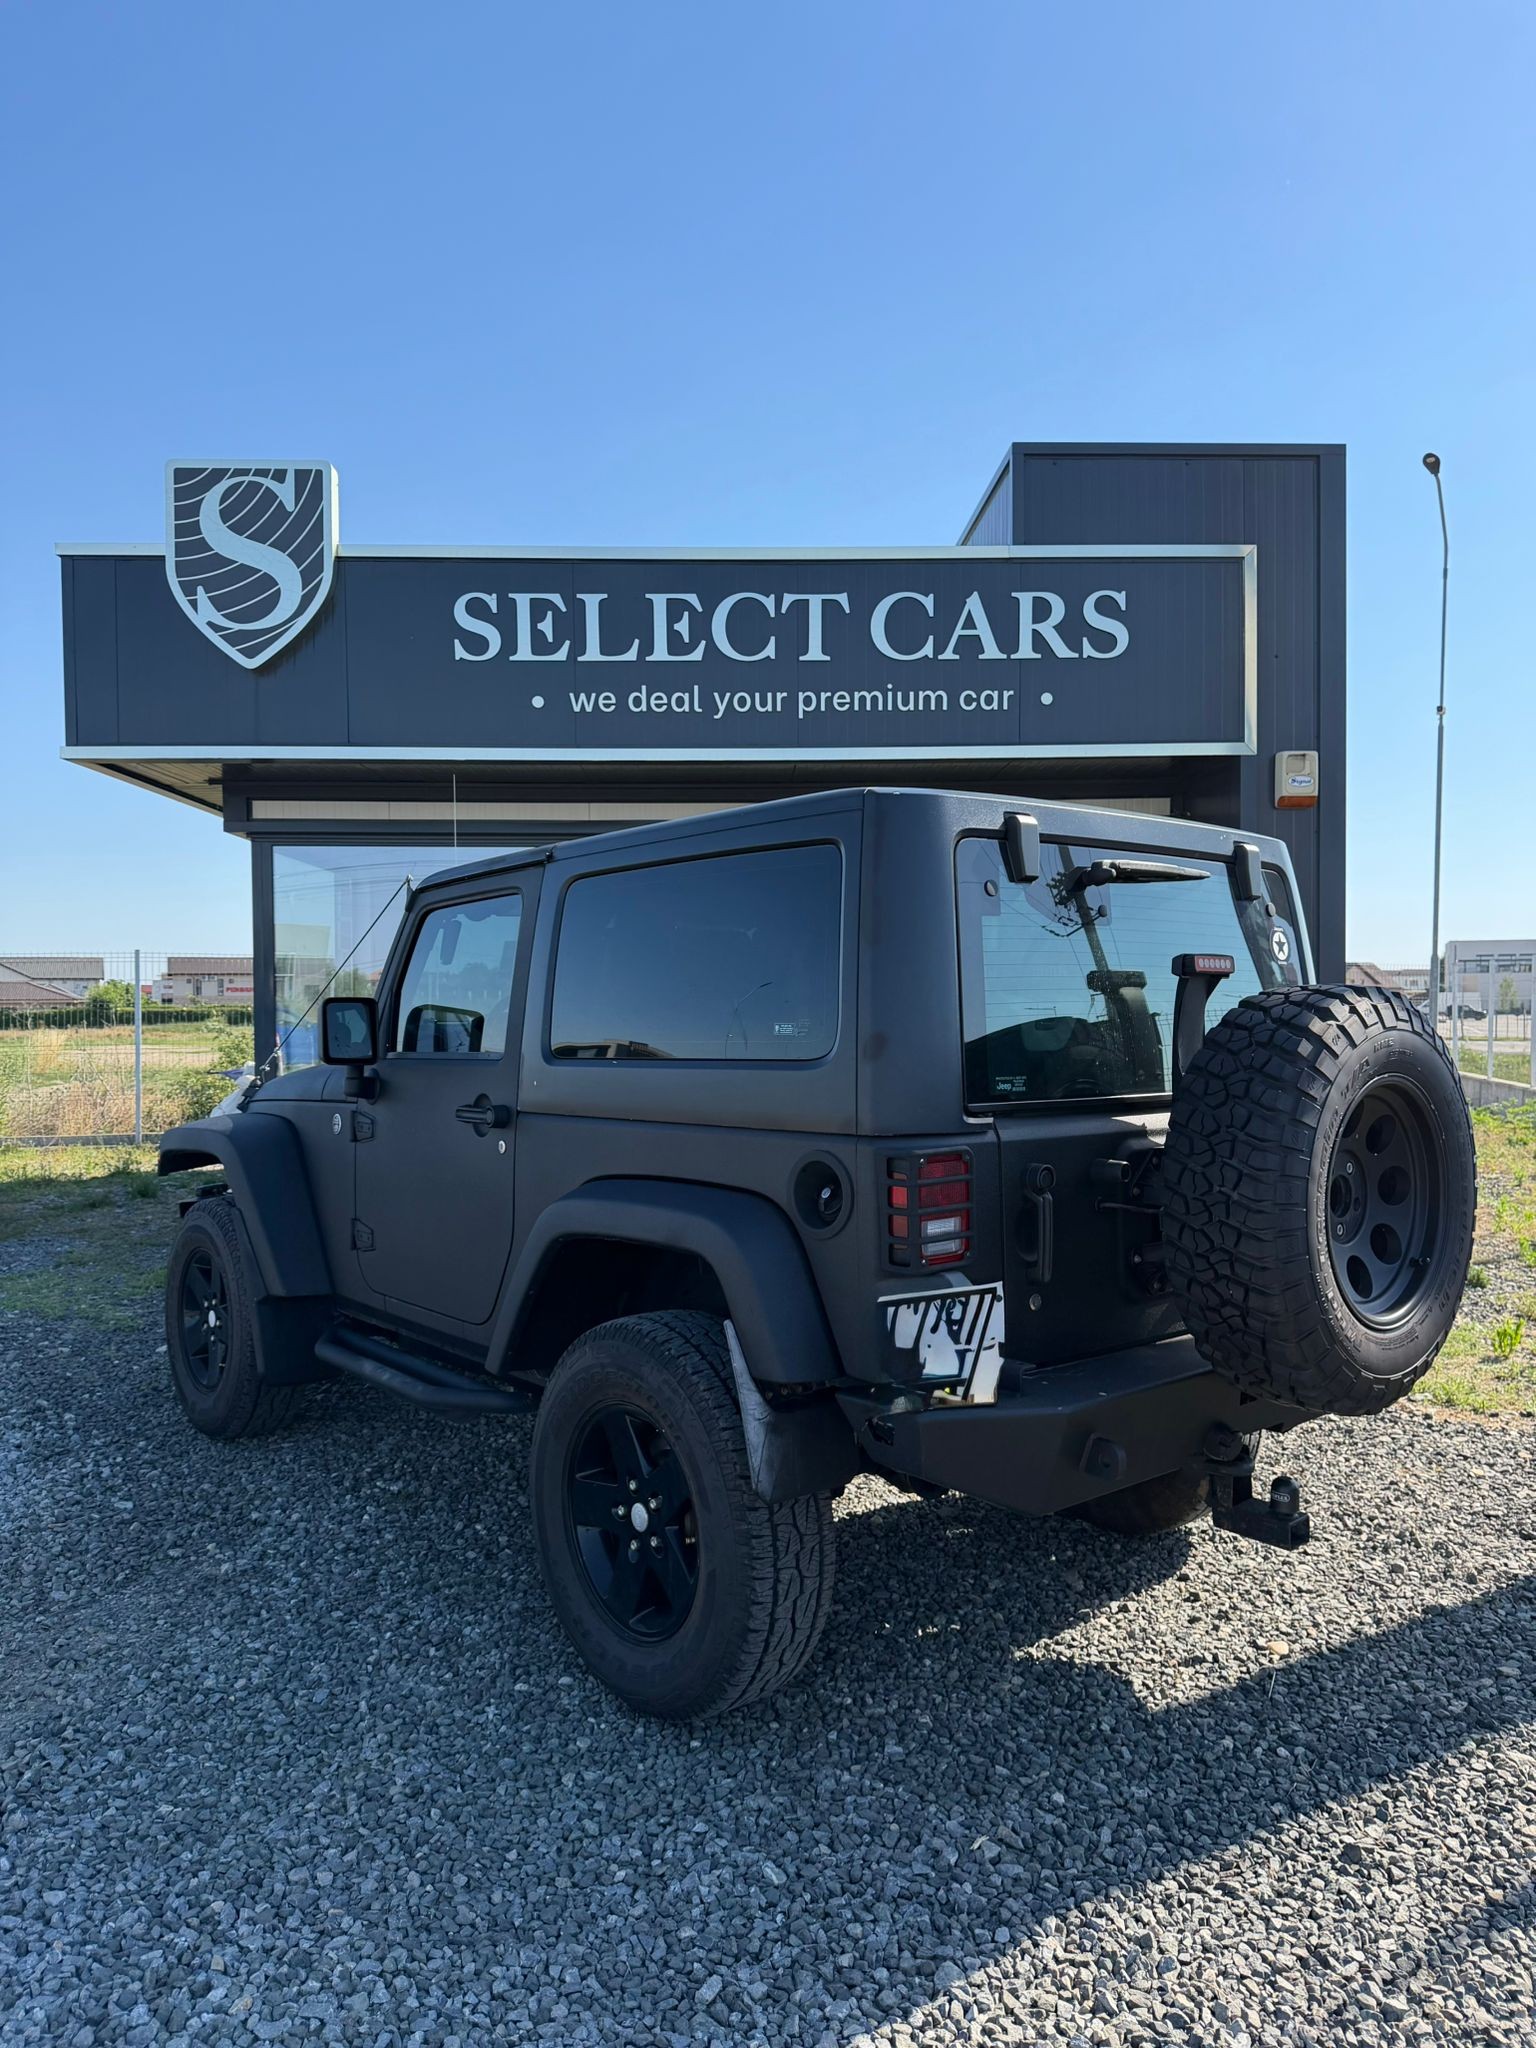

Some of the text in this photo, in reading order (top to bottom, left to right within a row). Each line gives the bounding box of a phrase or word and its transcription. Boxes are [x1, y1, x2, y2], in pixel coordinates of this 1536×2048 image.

[197, 468, 302, 630] S
[453, 589, 1130, 662] SELECT CARS
[569, 683, 1015, 720] we deal your premium car
[1291, 778, 1312, 786] Signal
[997, 1082, 1011, 1091] Jeep
